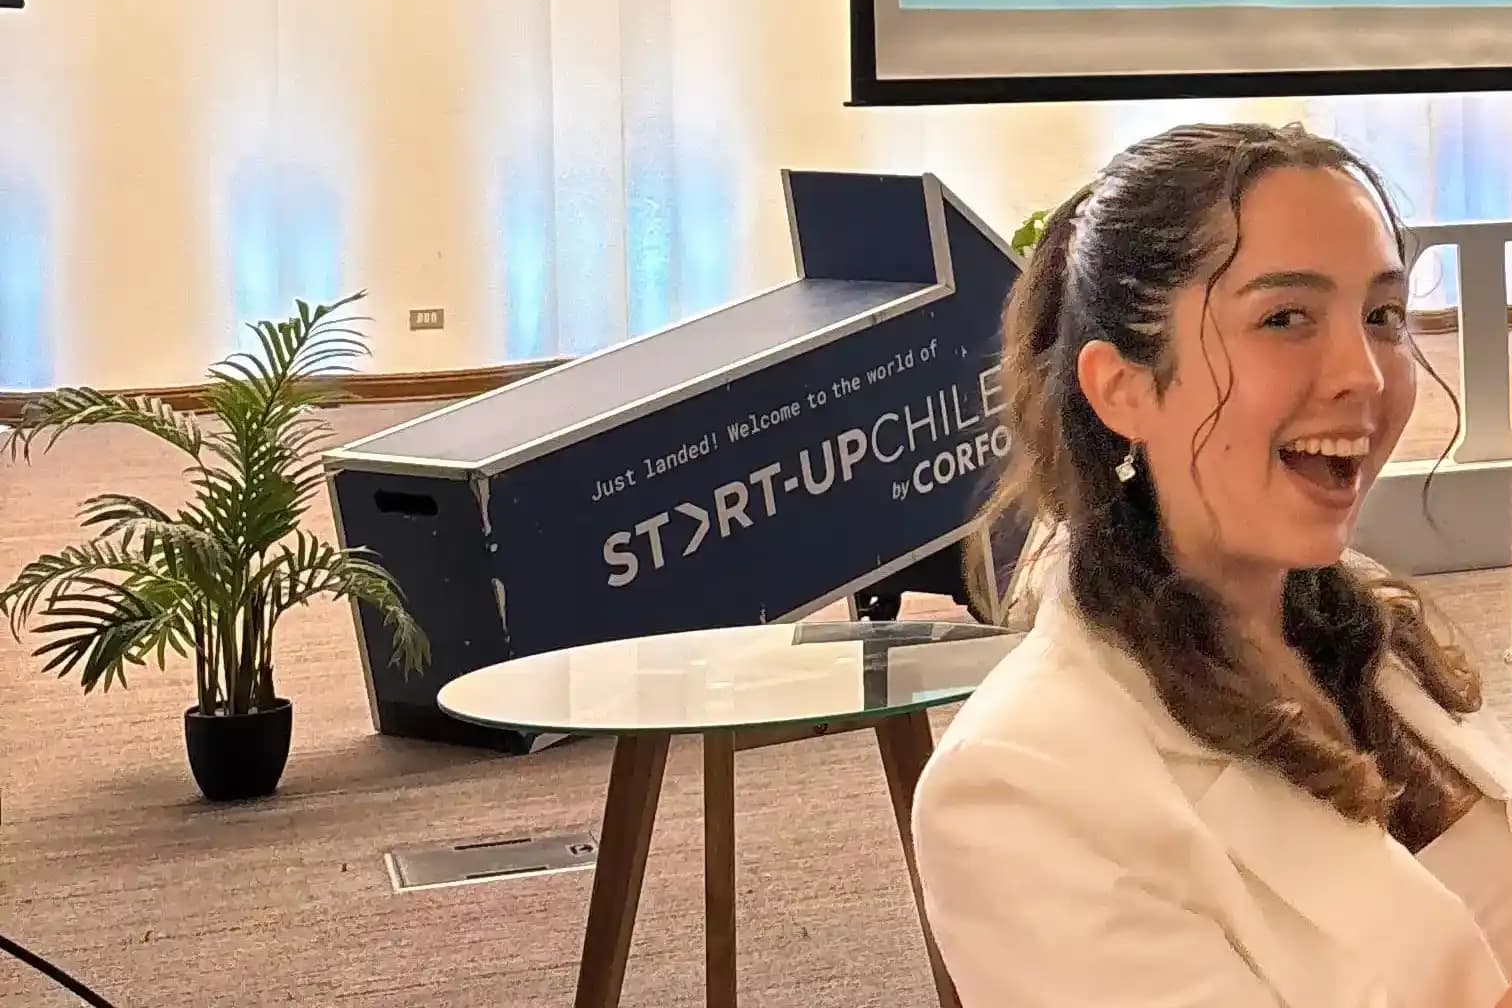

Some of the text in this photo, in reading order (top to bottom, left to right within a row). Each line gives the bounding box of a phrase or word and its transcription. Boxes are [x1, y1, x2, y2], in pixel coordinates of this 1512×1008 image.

[591, 338, 937, 502] Just landed! Welcome to the world of
[892, 424, 1012, 501] by CORFO
